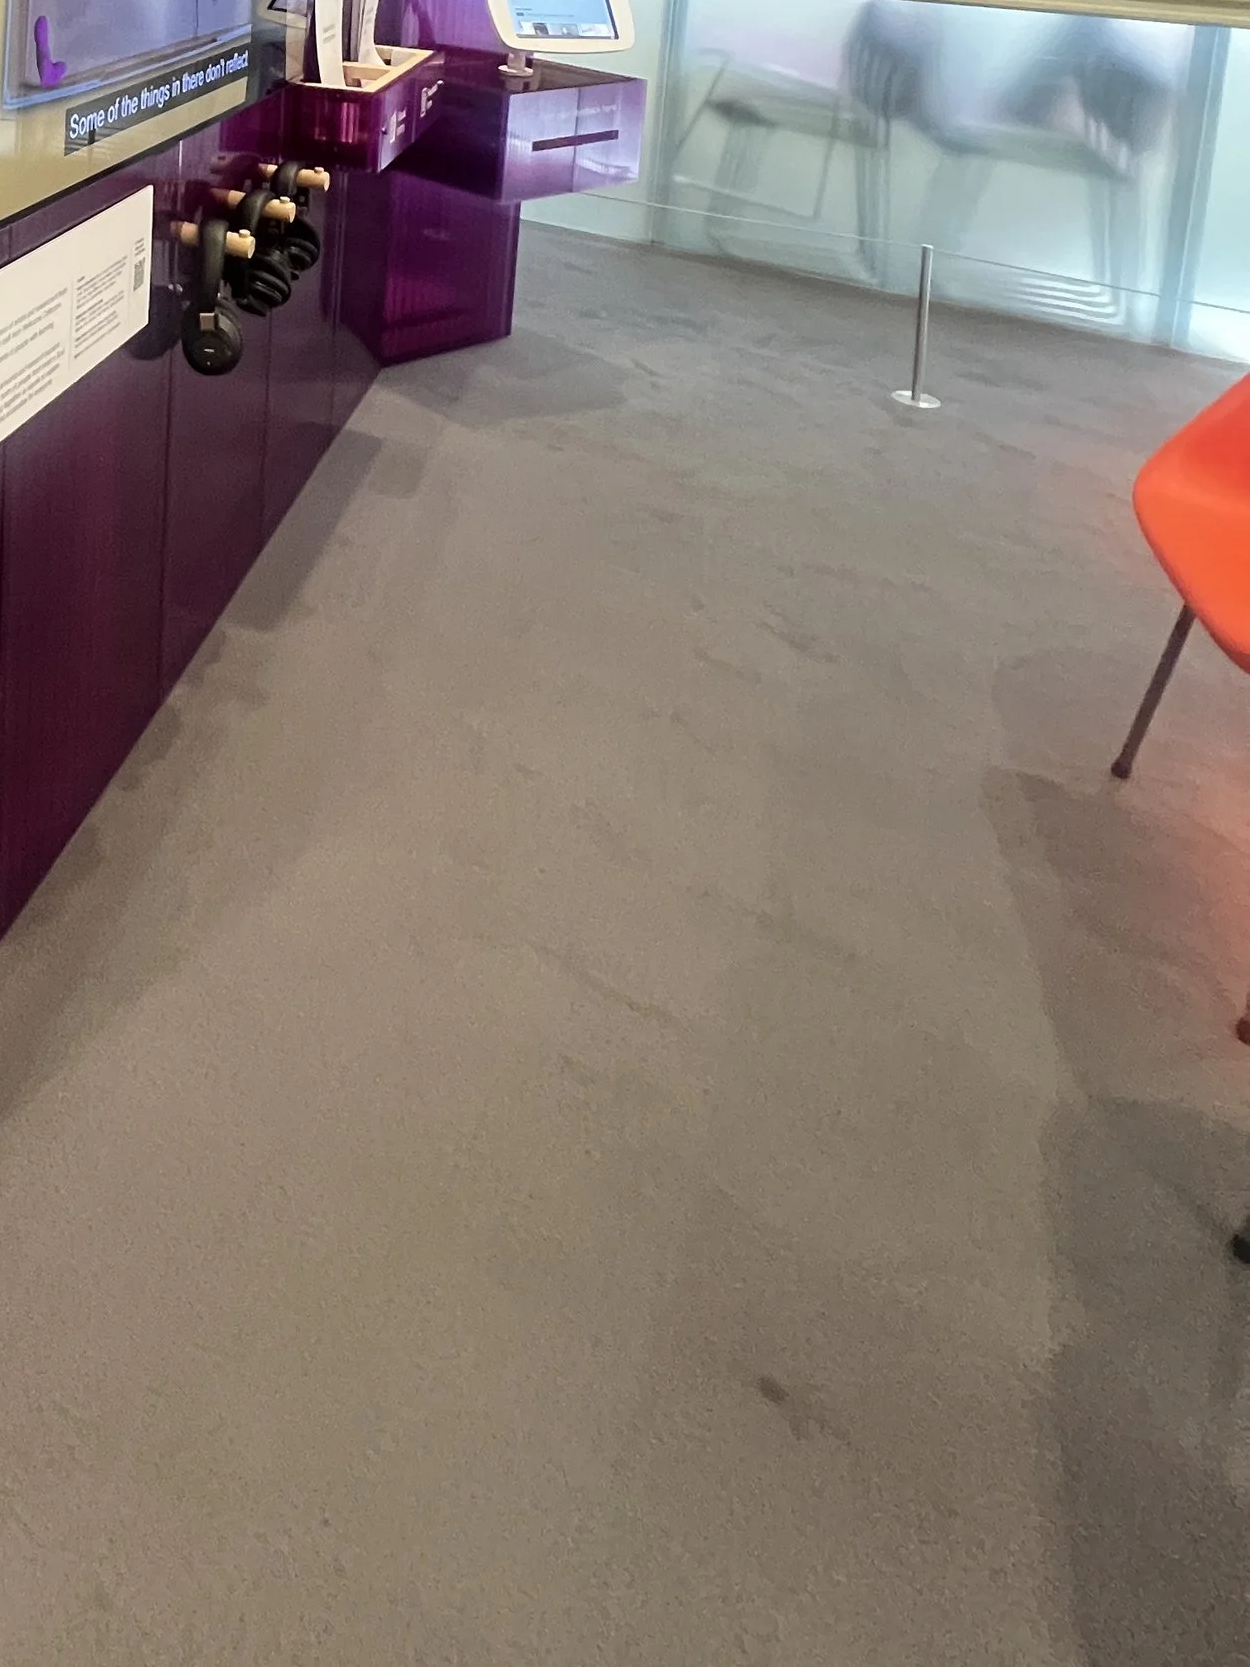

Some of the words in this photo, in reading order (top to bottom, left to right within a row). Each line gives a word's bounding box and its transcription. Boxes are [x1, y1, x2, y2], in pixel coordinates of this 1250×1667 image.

[69, 109, 105, 139] Some
[107, 97, 121, 123] of
[121, 94, 139, 118] the
[140, 84, 170, 109] things
[171, 76, 181, 98] in
[182, 70, 204, 93] there
[205, 58, 226, 83] don't
[225, 50, 249, 74] reflect
